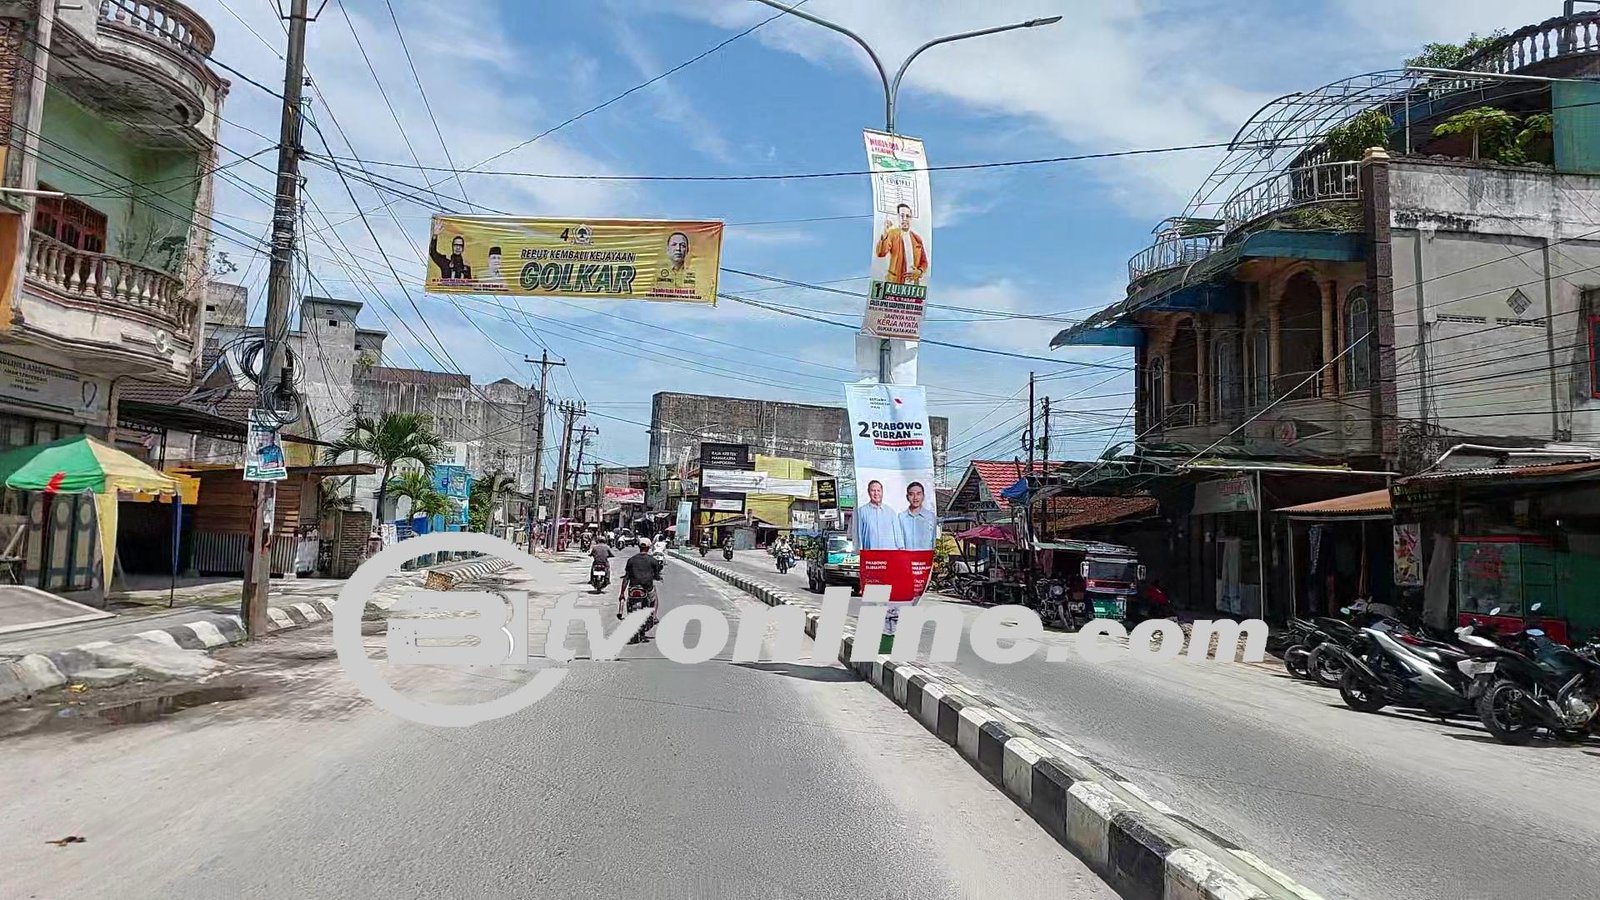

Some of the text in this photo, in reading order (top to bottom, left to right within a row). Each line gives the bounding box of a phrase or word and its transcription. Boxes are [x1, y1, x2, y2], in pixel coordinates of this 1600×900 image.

[560, 228, 570, 241] 4
[521, 249, 636, 262] REBUT KEMBALI KEJAYAAN
[520, 261, 636, 294] GOLKAR
[886, 284, 925, 298] ZULKIFLI
[877, 319, 918, 329] KERJA NYATA
[858, 421, 871, 438] 2
[872, 422, 922, 430] PRABOWO
[872, 430, 911, 439] GIBRAN
